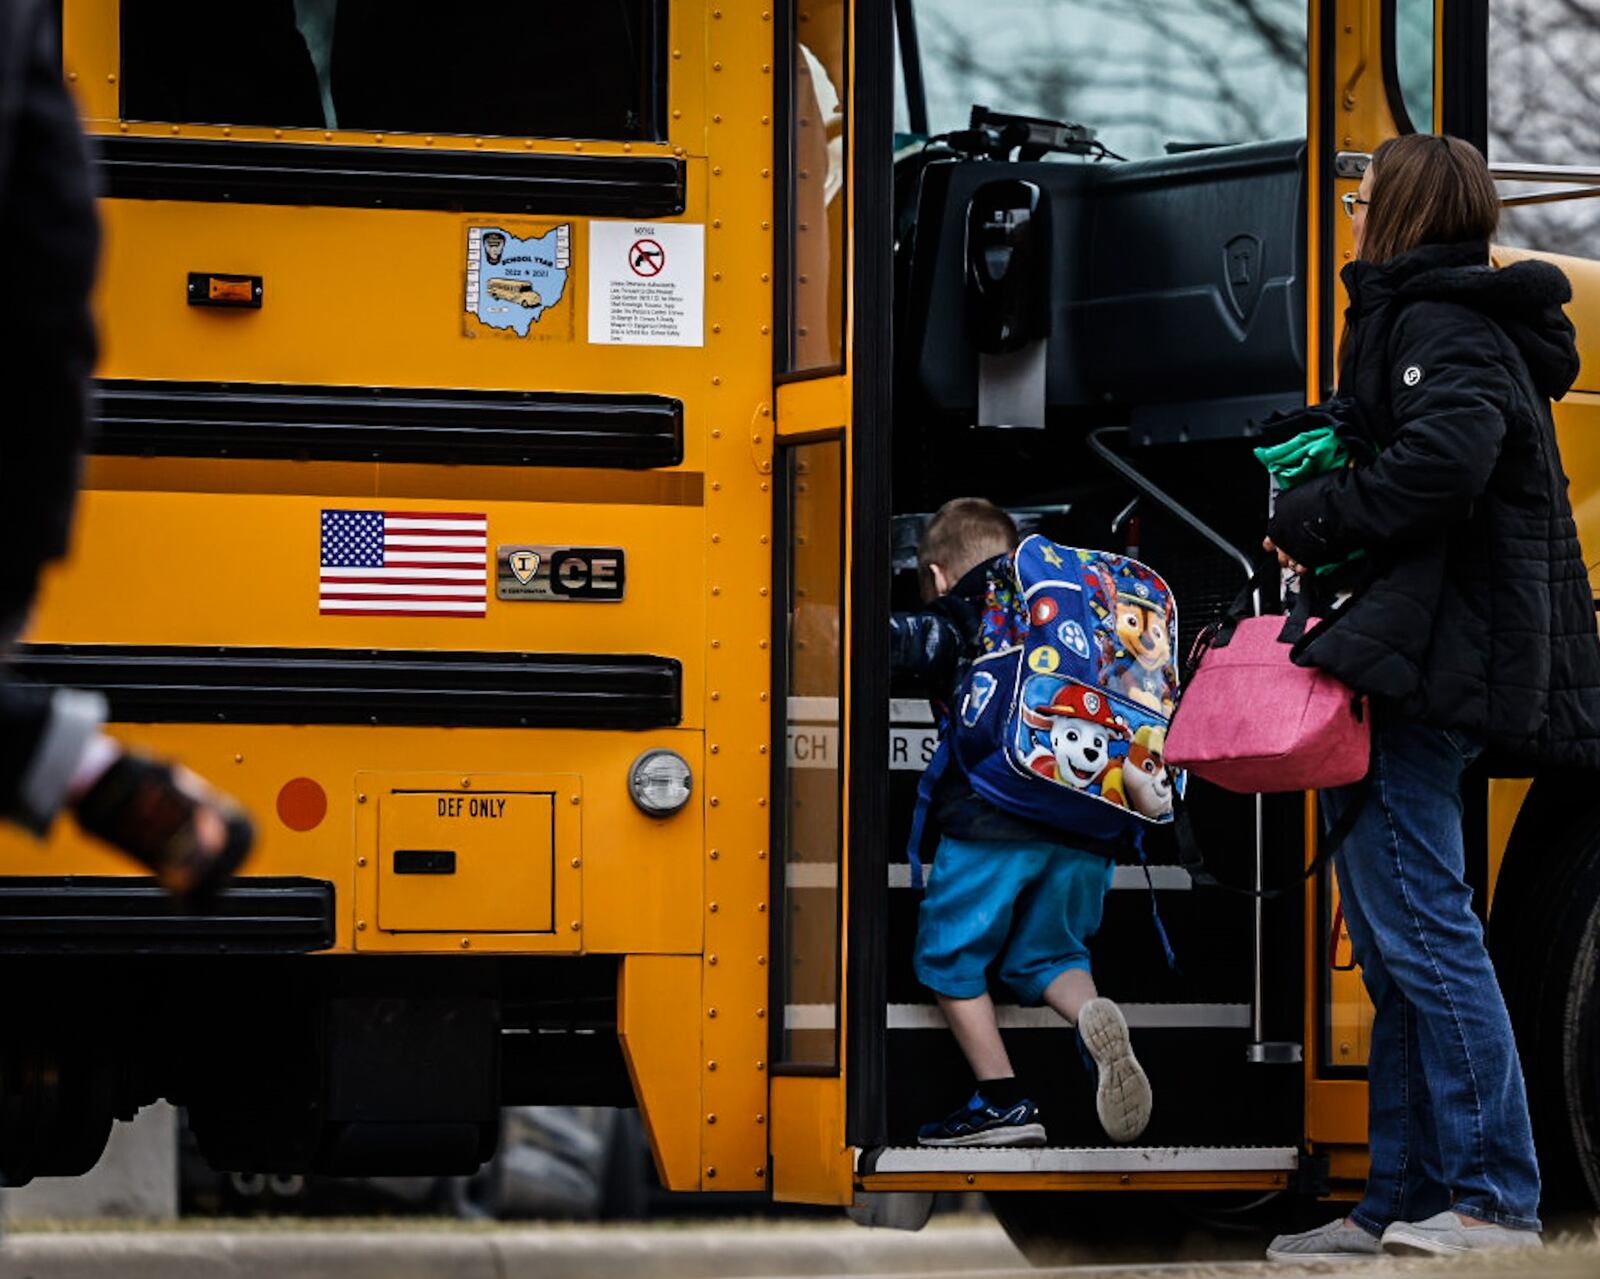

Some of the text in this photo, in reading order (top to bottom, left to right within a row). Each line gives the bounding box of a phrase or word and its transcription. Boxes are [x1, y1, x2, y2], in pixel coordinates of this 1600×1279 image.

[502, 255, 553, 267] SCHOOL YEAR
[558, 557, 617, 589] CE
[438, 798, 506, 818] DEF ONLY
